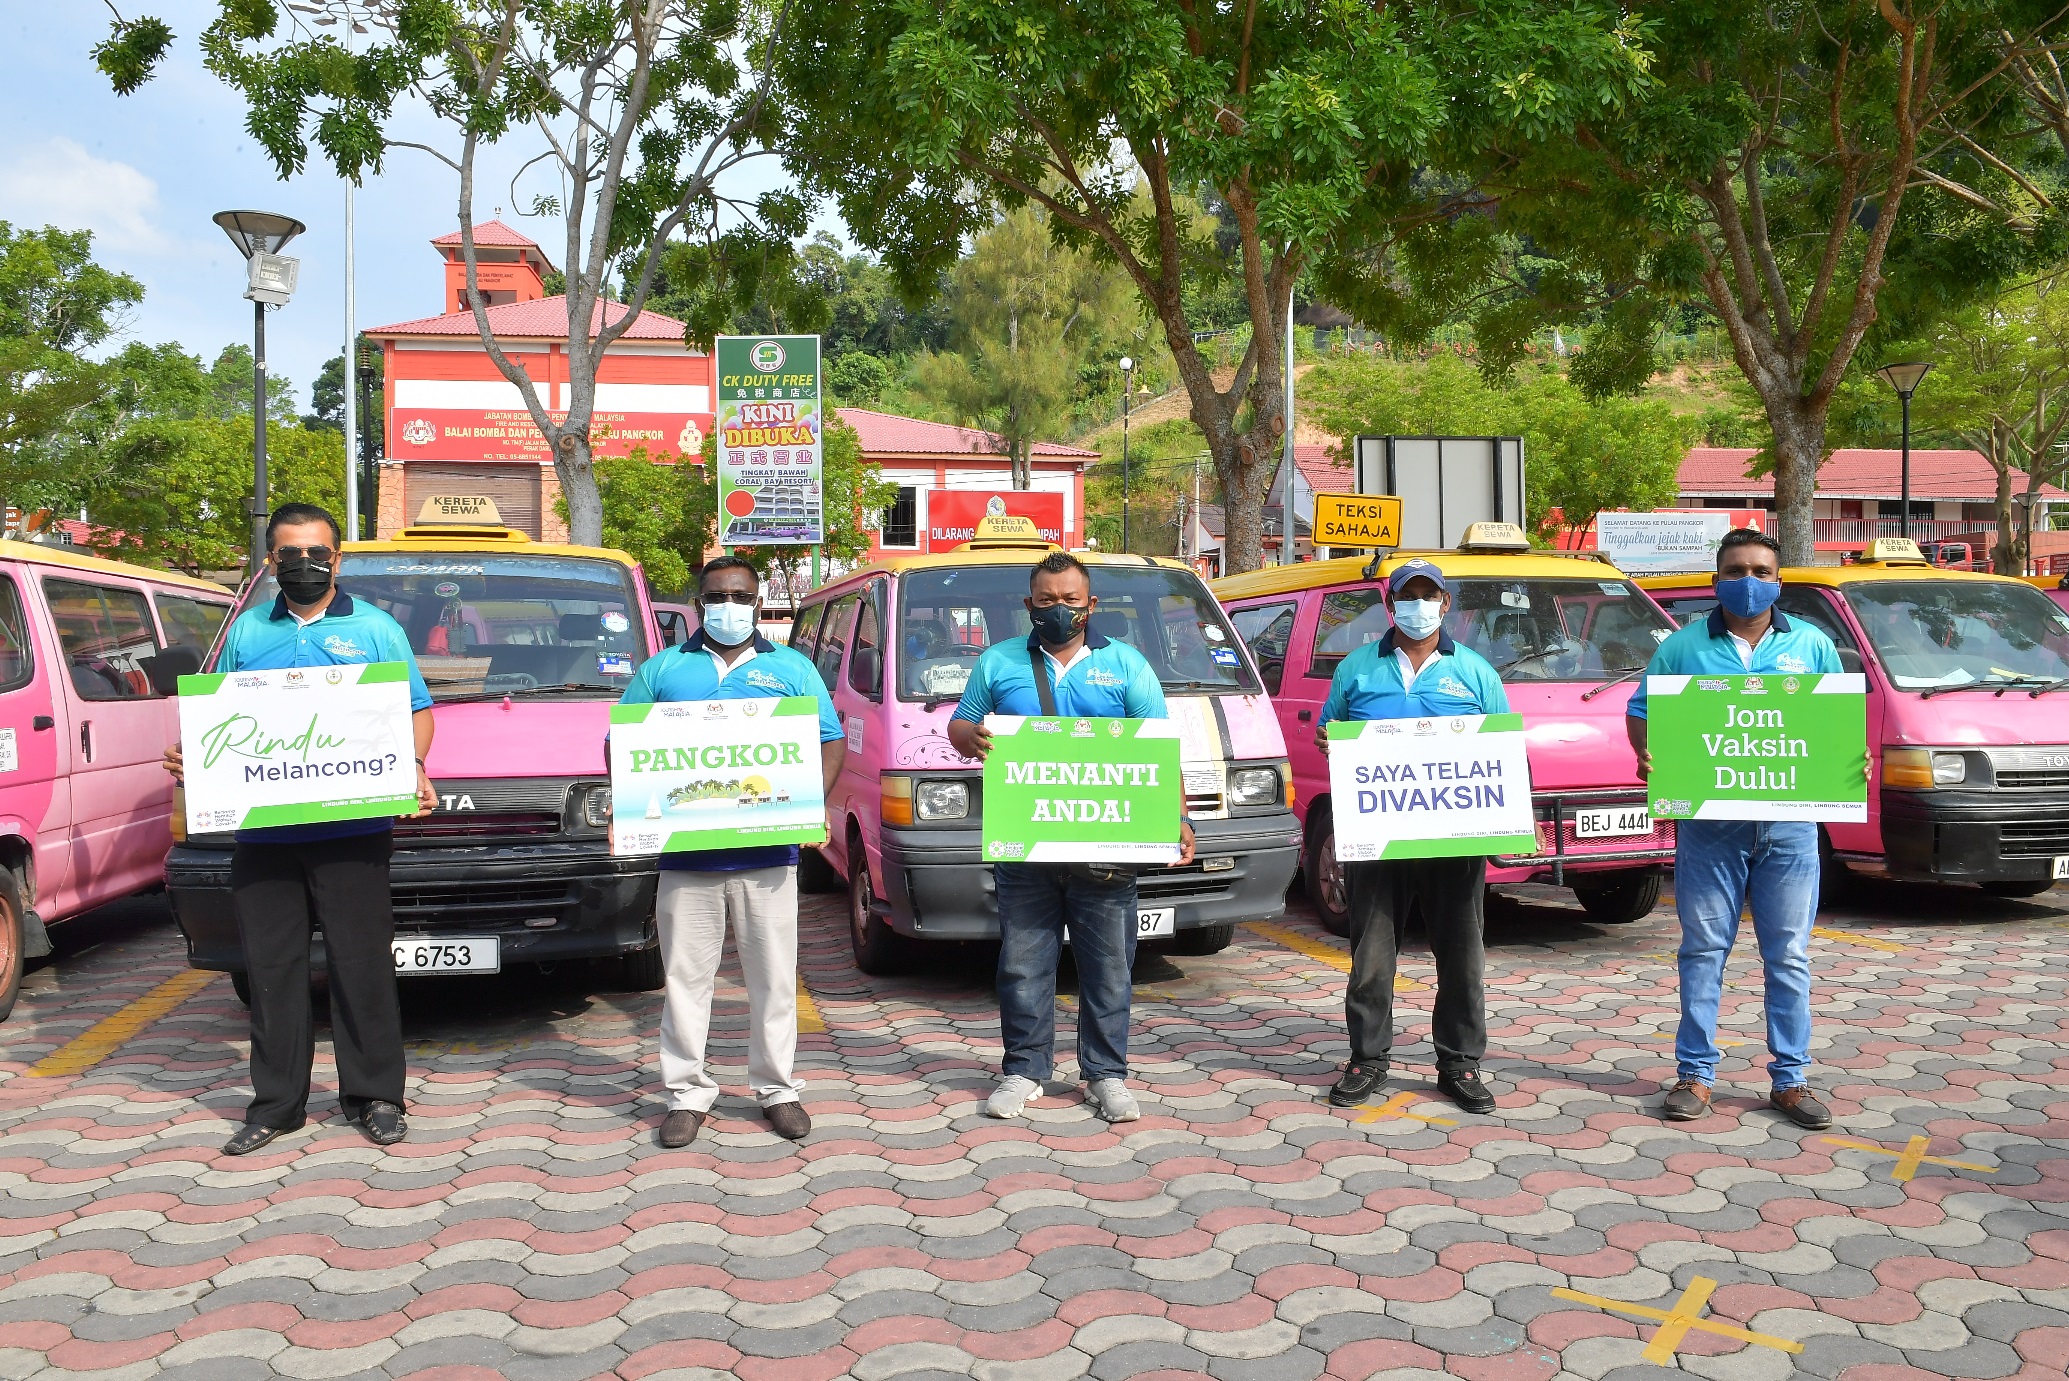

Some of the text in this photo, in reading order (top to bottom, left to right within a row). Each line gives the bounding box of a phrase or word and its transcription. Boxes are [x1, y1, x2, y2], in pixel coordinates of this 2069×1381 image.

[722, 374, 814, 386] CK DUTY FREE
[737, 388, 801, 398] 免税商店
[484, 412, 512, 420] JABATAN
[594, 414, 625, 422] MALAYSIA
[742, 402, 794, 423] KINI
[445, 427, 472, 437] BALAI
[474, 428, 506, 438] BOMBA
[508, 428, 526, 438] DAN
[622, 430, 664, 440] PANGKOR
[725, 426, 816, 448] DIBUKA
[728, 450, 812, 466] 正式营业
[434, 497, 487, 506] KERETA
[441, 506, 480, 514] SEWA
[1336, 504, 1382, 519] TEKSI
[932, 528, 974, 540] DILARANG
[1325, 522, 1390, 538] SAHAJA
[1604, 531, 1703, 549] Tinggalkan jejak kaki
[1725, 704, 1784, 728] Jom
[201, 713, 346, 769] Rindu
[1702, 733, 1808, 757] Vaksin
[630, 742, 804, 772] PANGKOR
[245, 754, 397, 782] Melancong?
[1005, 762, 1160, 786] MENANTI
[1356, 760, 1502, 784] SAYA TELAH
[1714, 766, 1796, 790] Dulu!
[1357, 784, 1505, 814] DIVAKSIN
[1031, 799, 1130, 822] ANDA!
[1582, 812, 1648, 832] BEJ 4441
[1137, 912, 1162, 932] 87
[414, 945, 472, 967] 6753
